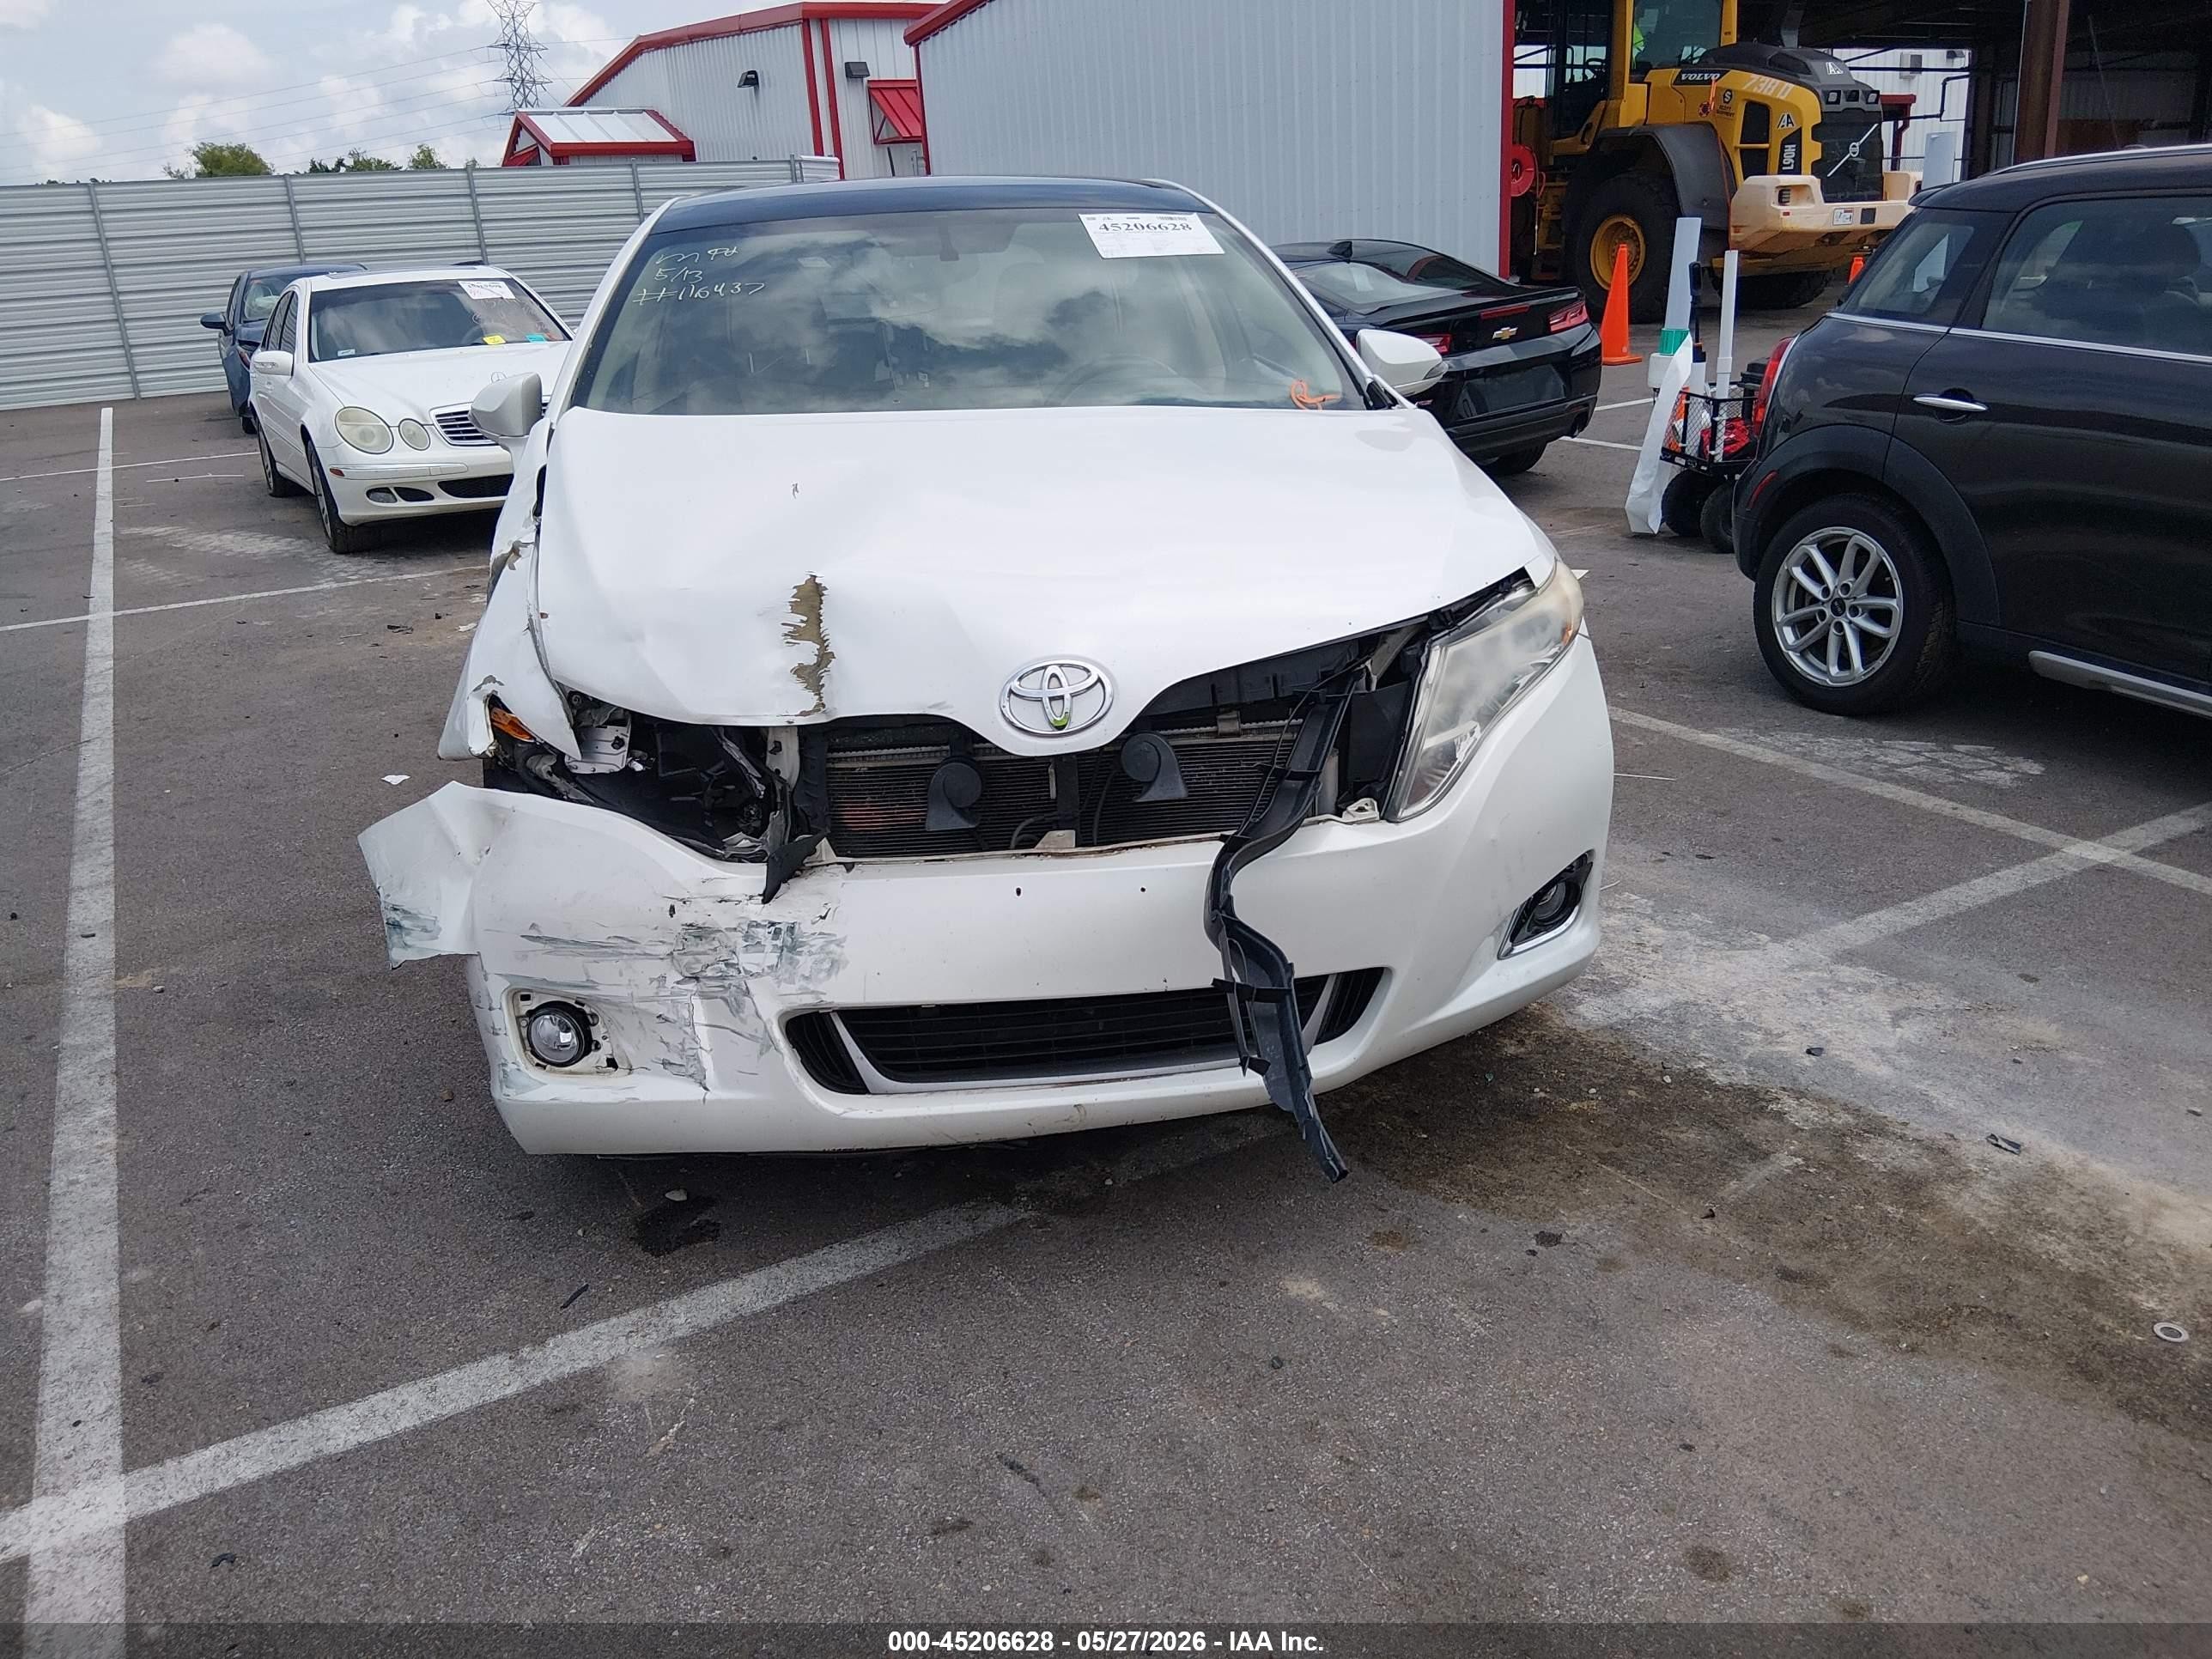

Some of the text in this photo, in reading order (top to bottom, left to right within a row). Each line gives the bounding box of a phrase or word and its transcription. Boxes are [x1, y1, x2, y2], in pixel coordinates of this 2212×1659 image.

[1782, 144, 1796, 170] L90H
[1098, 222, 1193, 233] 45206628
[653, 266, 703, 284] 5/13
